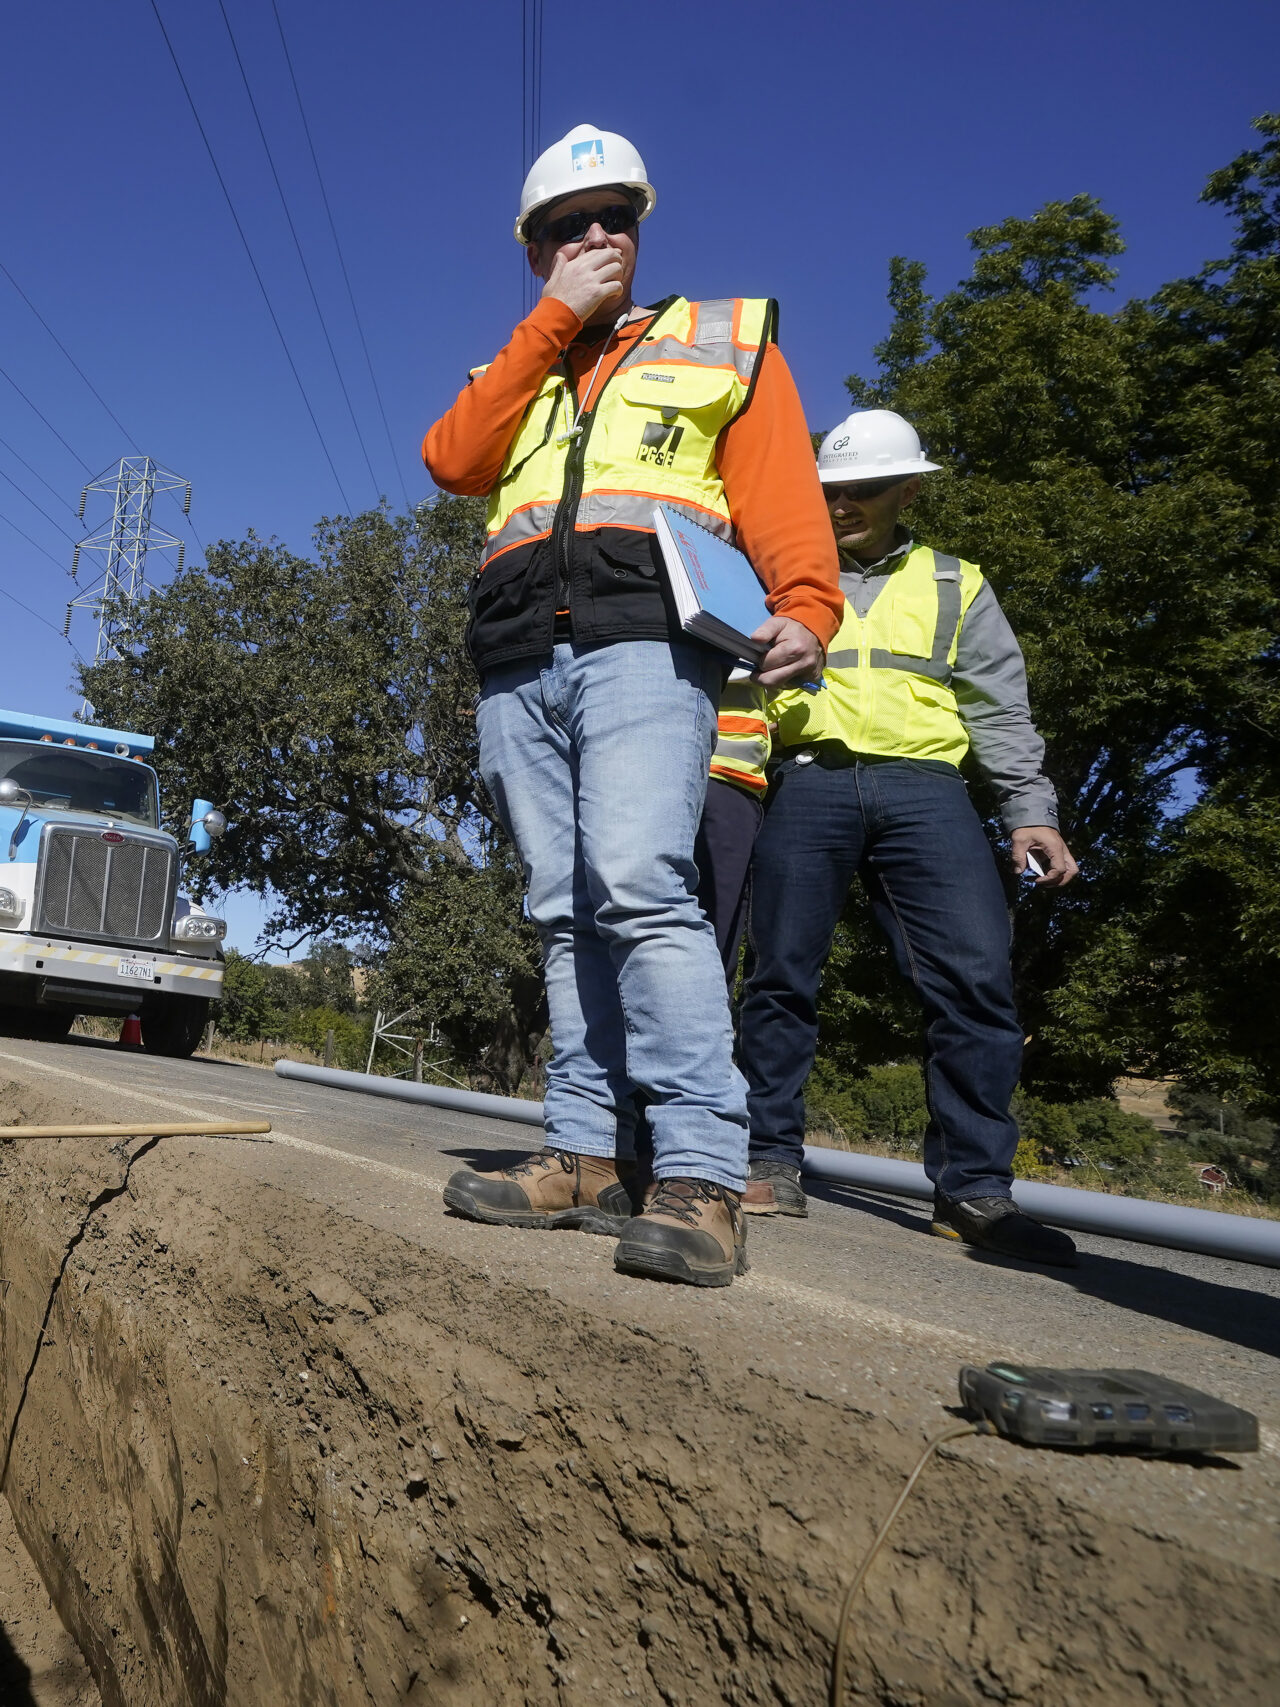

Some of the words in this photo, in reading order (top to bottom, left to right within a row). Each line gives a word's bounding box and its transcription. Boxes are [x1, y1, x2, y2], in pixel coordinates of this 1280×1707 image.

[573, 153, 605, 171] P&E
[833, 435, 850, 451] G2
[638, 444, 676, 468] PG&E
[823, 452, 858, 460] INTEGRATED
[120, 964, 151, 978] 11627N1
